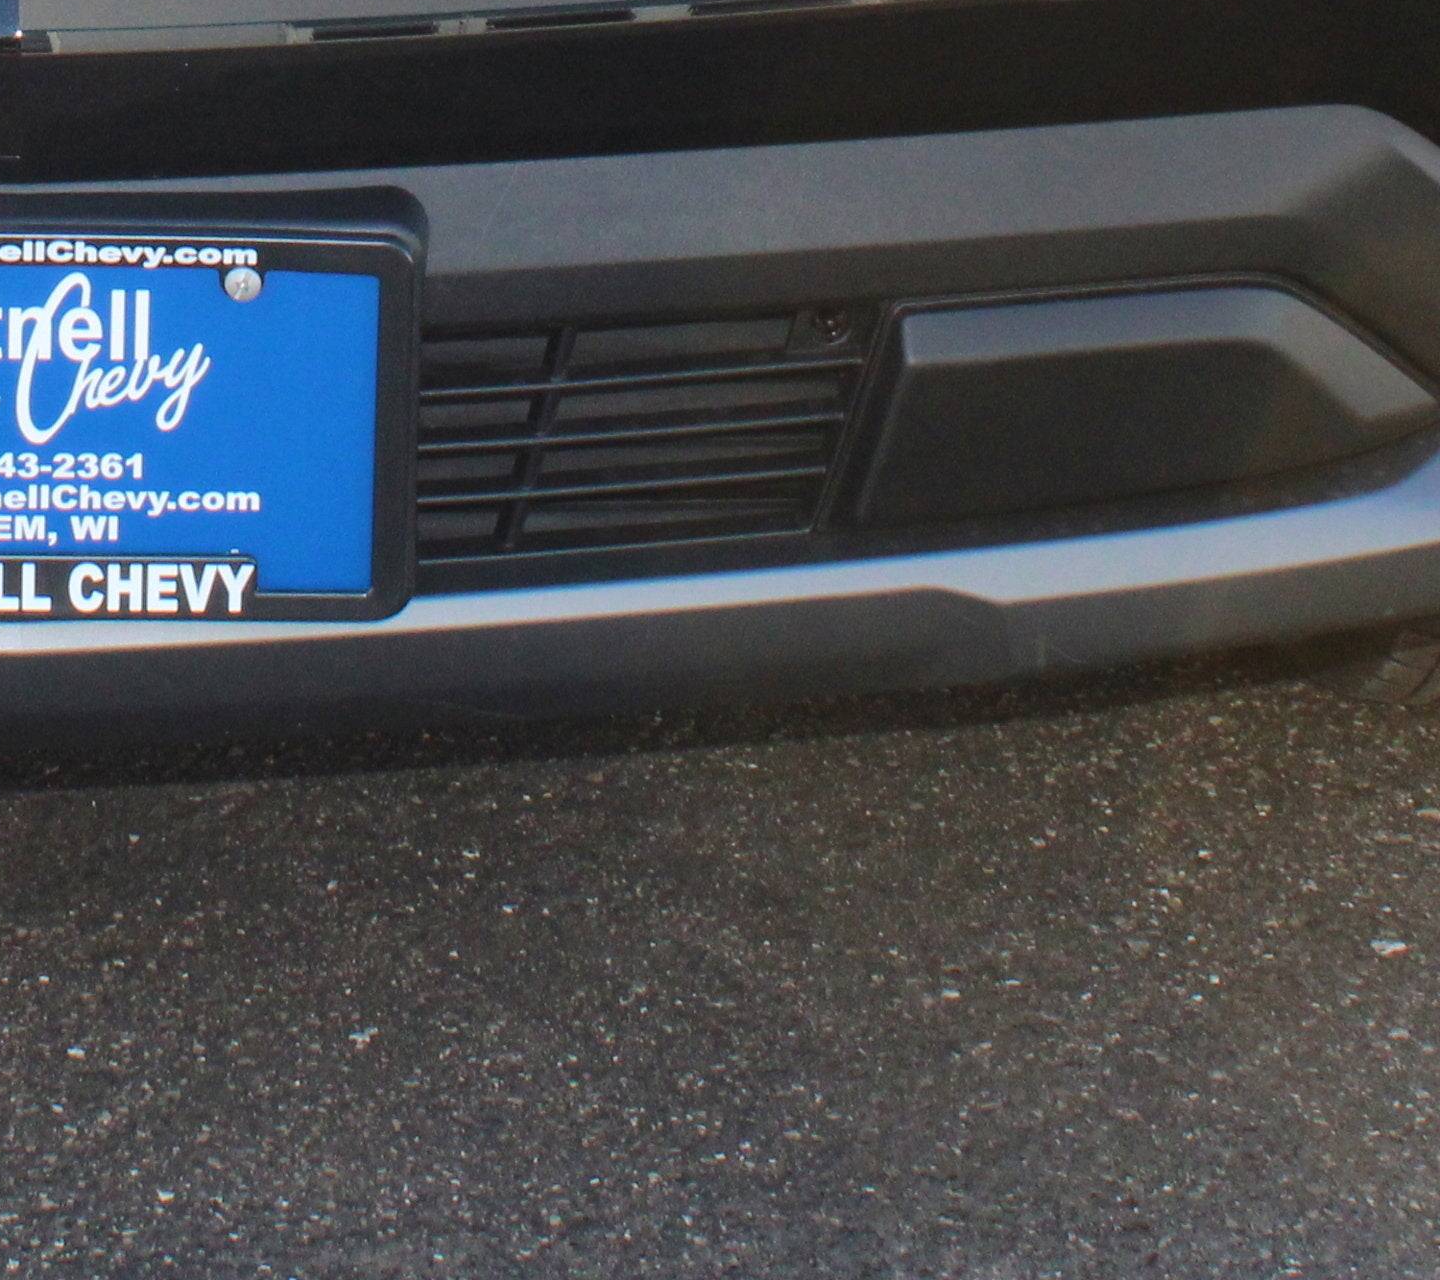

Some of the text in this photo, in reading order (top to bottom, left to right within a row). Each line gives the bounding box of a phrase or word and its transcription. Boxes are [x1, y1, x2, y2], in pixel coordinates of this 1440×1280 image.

[15, 272, 212, 445] Chevy
[68, 515, 121, 542] WI
[67, 562, 256, 614] CHEVY
